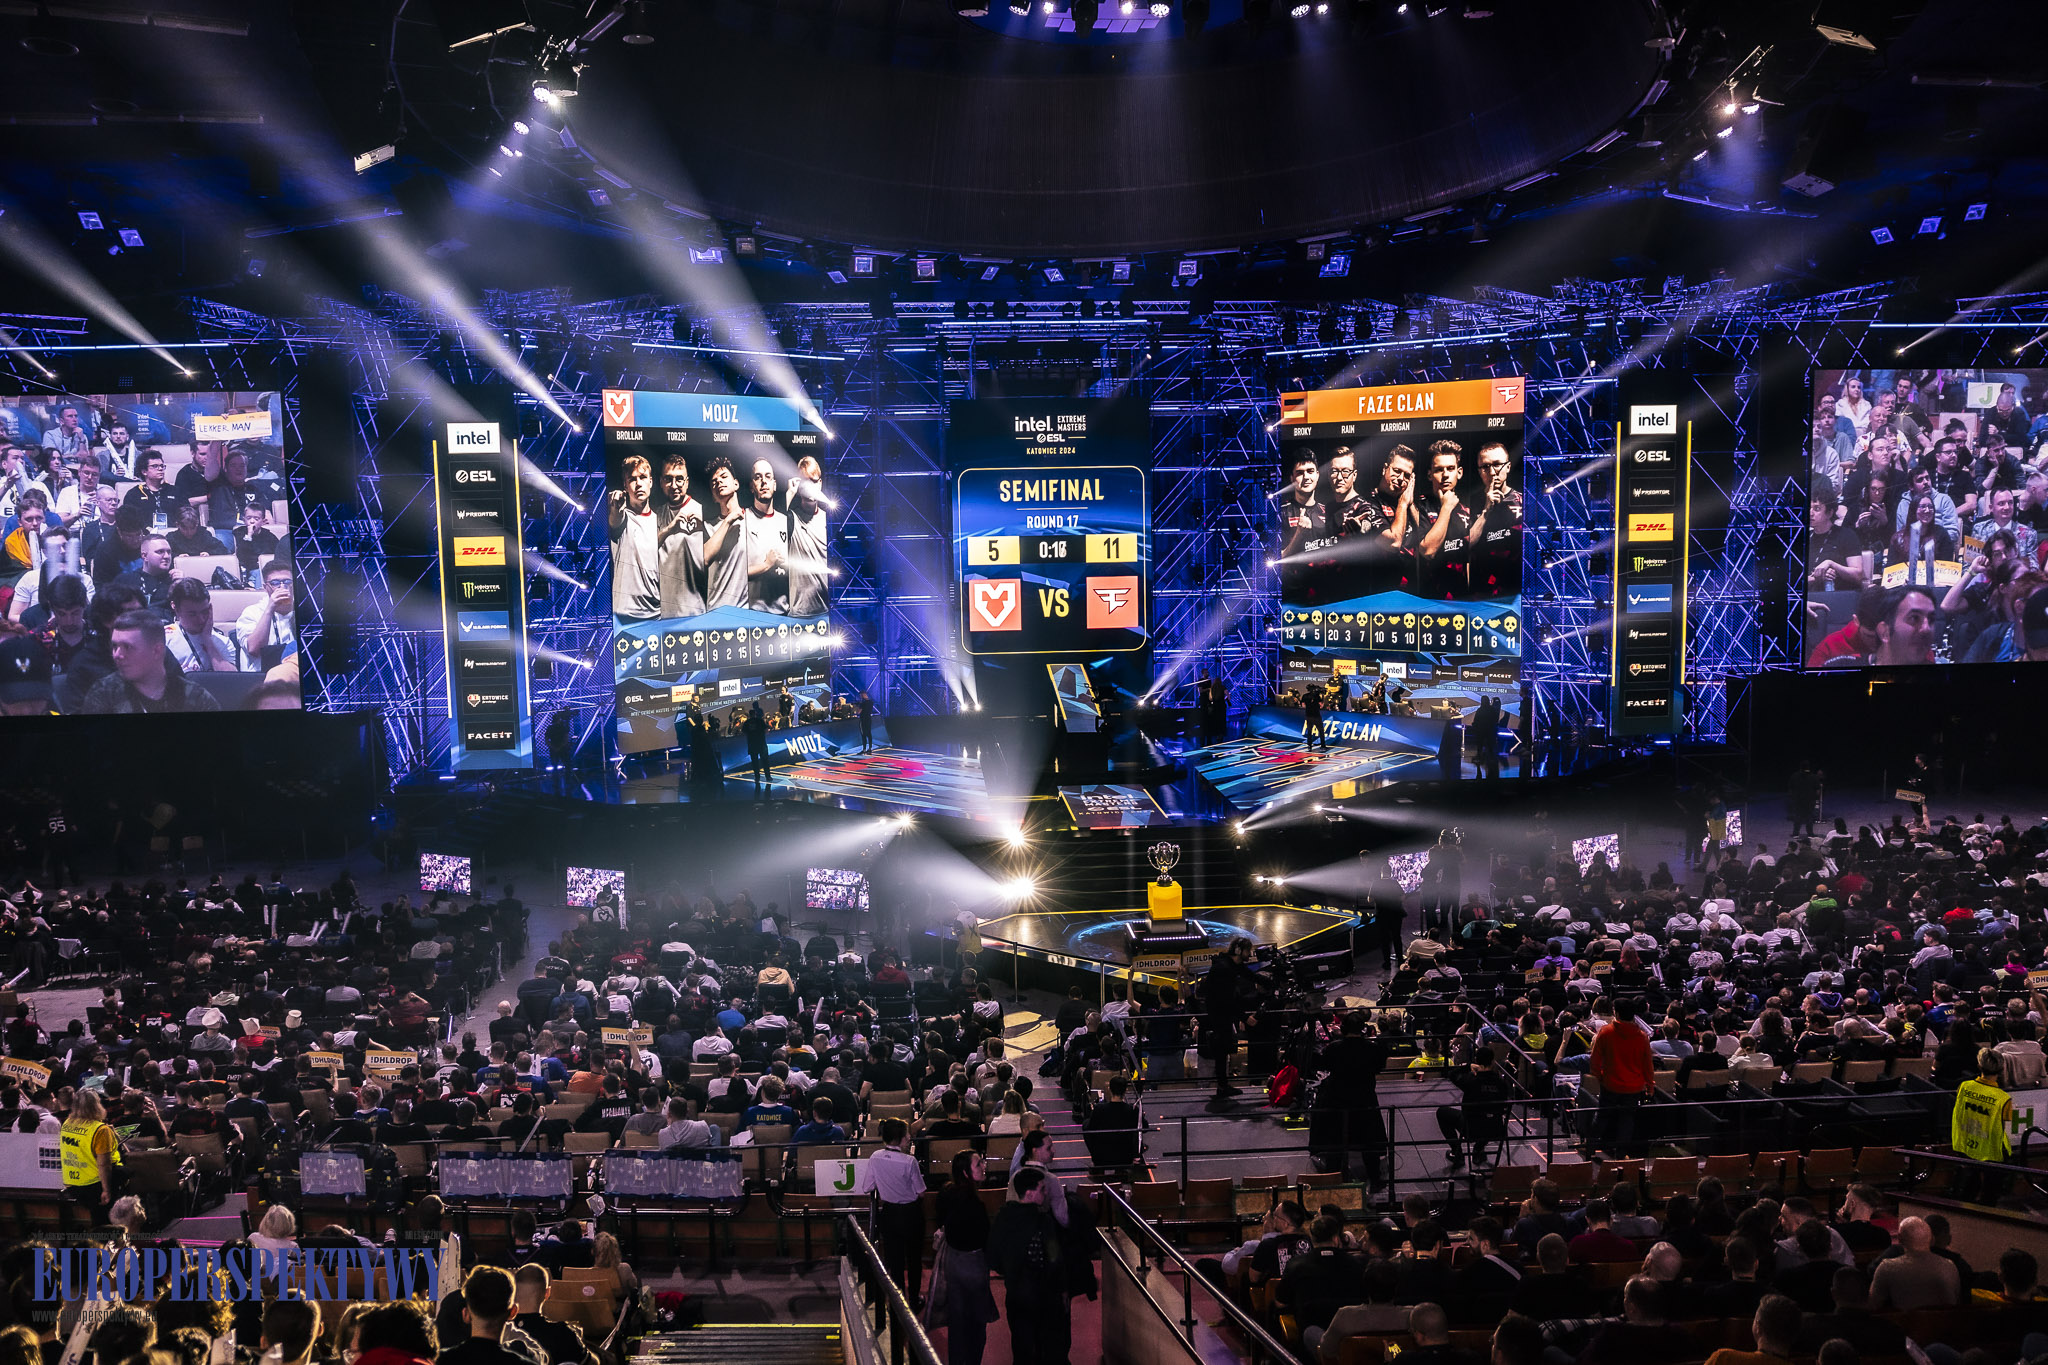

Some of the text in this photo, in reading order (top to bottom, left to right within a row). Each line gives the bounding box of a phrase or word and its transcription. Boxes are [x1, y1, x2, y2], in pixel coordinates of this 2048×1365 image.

[1979, 386, 1993, 404] J
[1358, 392, 1434, 414] FAZE CLAN
[702, 403, 739, 423] MOUZ
[1057, 415, 1087, 424] EXTREME
[1638, 412, 1668, 426] intel
[199, 422, 251, 433] LEKKER MAN
[1057, 423, 1087, 432] MASTERS
[1380, 422, 1410, 432] KARRIGAN
[1432, 420, 1457, 430] FROZEN
[1487, 417, 1505, 428] ROPZ
[616, 431, 643, 441] BROLLAN
[1293, 427, 1312, 437] BROKY
[1341, 425, 1355, 434] RAIN
[456, 430, 491, 445] intel
[666, 431, 687, 442] TORZSI
[713, 433, 730, 443] SIUHY
[753, 434, 775, 443] XERTION
[791, 435, 816, 444] JIMPPHAT
[1046, 433, 1065, 442] ESL
[1026, 446, 1076, 455] KATOWICE 2024
[1647, 450, 1671, 461] ESL
[469, 470, 496, 482] ESL
[1000, 478, 1104, 503] SEMIFINAL
[1026, 515, 1079, 529] ROUND 17
[1635, 523, 1667, 531] DHL
[461, 547, 498, 555] DHL
[988, 539, 1000, 562] 5
[1103, 537, 1120, 559] 11
[1038, 588, 1070, 618] VS
[1284, 627, 1320, 640] 13 4 5
[1328, 629, 1365, 642] 20 3 7
[1375, 631, 1415, 644] 10 5 10
[1422, 633, 1462, 647] 13 3 9
[1472, 635, 1516, 649] 11 6 11
[712, 646, 747, 661] 9 2 15
[755, 642, 788, 657] 5 0 12
[620, 655, 659, 671] 5 2 15
[665, 651, 704, 666] 14 2 14
[1386, 666, 1403, 674] intel
[722, 683, 737, 692] intel
[1341, 721, 1382, 742] CLAN
[785, 733, 826, 757] MOUZ
[49, 820, 66, 834] 95
[1136, 960, 1176, 968] !DHLDROP
[607, 1032, 648, 1041] !DHLOP
[370, 1056, 412, 1064] !DHLDROP
[7, 1064, 46, 1081] !DHLDROP
[1964, 1089, 1998, 1104] SECURITY
[2011, 1107, 2034, 1134] H
[833, 1163, 855, 1191] J
